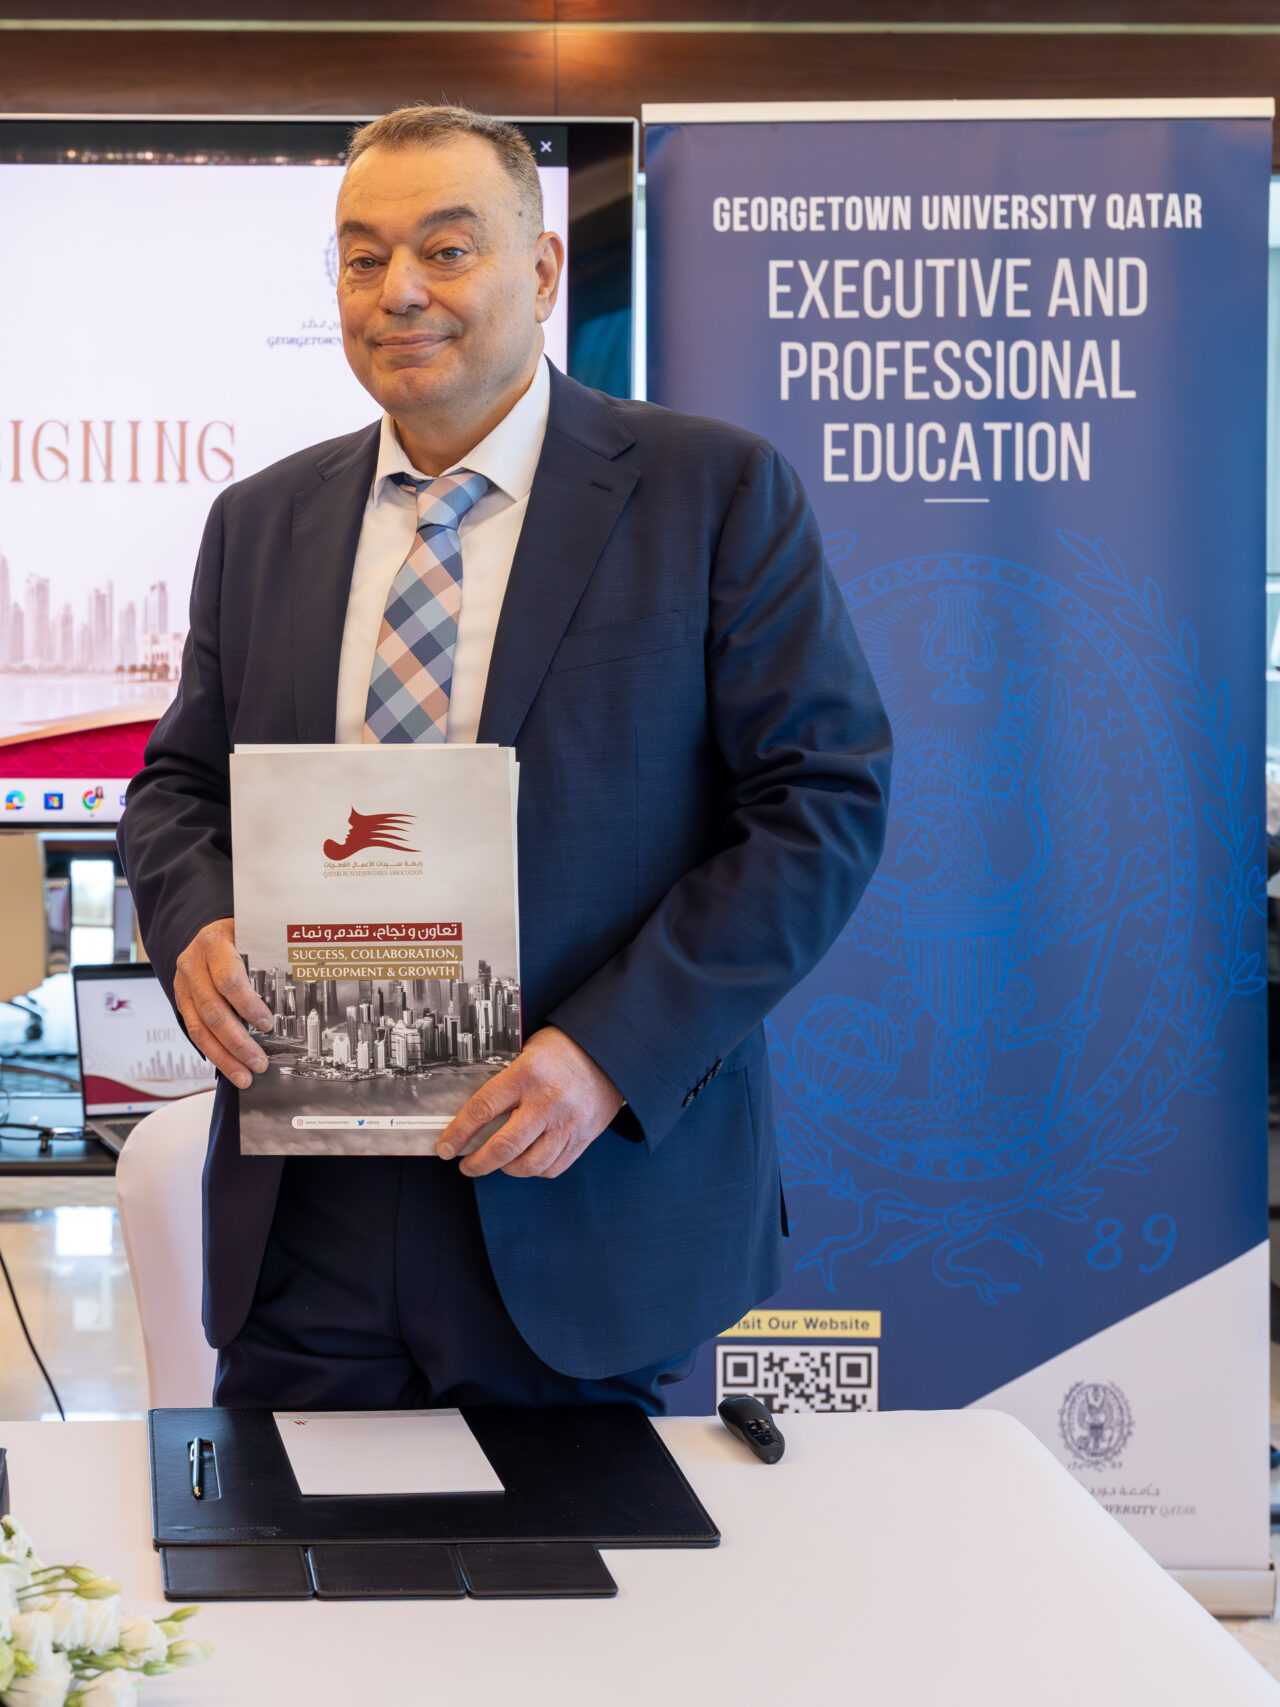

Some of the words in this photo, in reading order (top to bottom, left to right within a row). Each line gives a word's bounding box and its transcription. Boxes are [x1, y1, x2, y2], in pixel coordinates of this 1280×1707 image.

[712, 195, 912, 232] GEORGETOWN
[921, 194, 1096, 230] UNIVERSITY
[1105, 193, 1203, 230] QATAR
[768, 258, 1031, 319] EXECUTIVE
[1047, 257, 1148, 317] AND
[780, 340, 1136, 400] PROFESSIONAL
[823, 421, 1091, 482] EDUCATION
[292, 949, 348, 961] SUCCESS,
[350, 948, 458, 960] COLLABORATION,
[297, 966, 383, 978] DEVELOPMENT
[387, 968, 396, 977] &
[398, 966, 454, 977] GROWTH
[736, 1317, 762, 1331] isit
[768, 1317, 797, 1331] Our
[804, 1316, 870, 1331] Website
